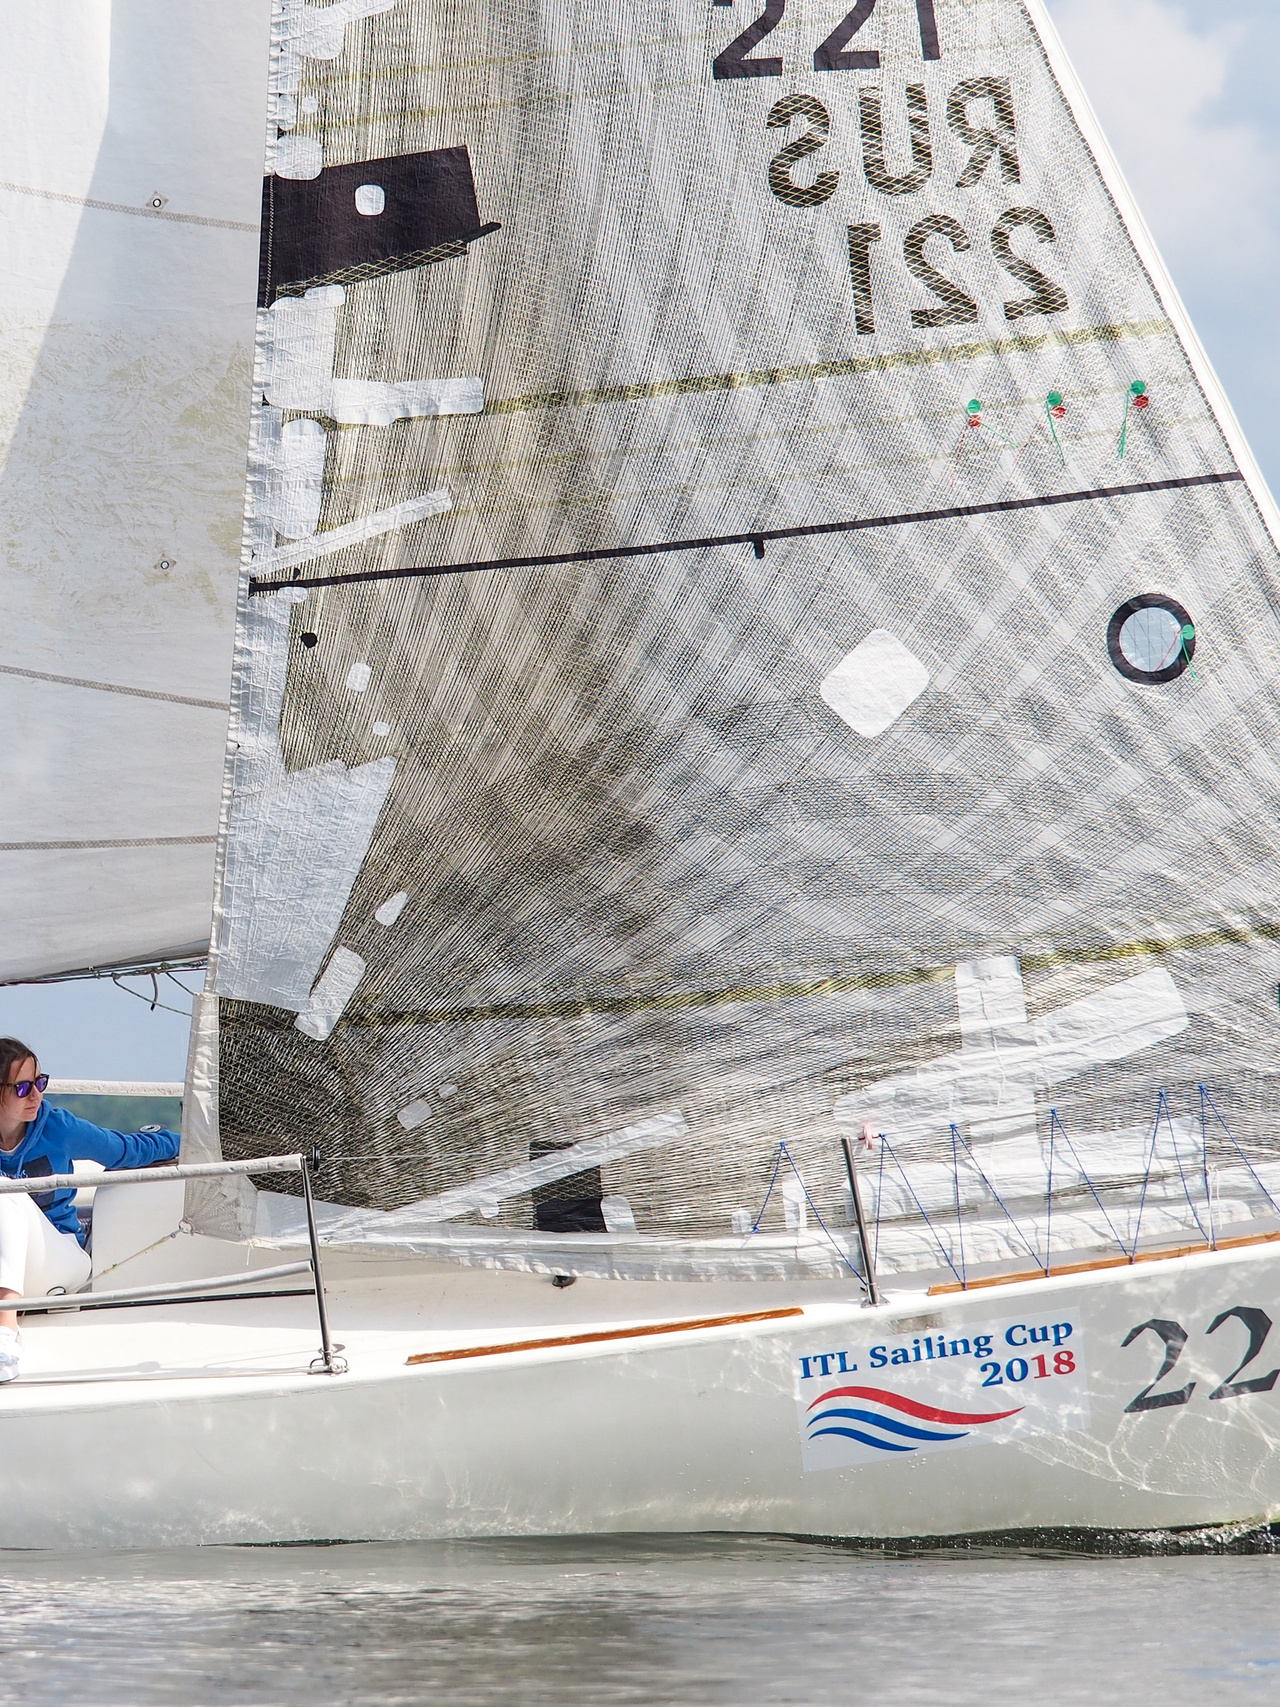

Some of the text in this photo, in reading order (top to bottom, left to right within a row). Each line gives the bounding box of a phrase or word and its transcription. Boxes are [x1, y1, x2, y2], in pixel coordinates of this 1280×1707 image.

[713, 0, 941, 80] 221
[798, 1322, 1074, 1380] ITL Sailing Cup
[979, 1349, 1077, 1388] 2018
